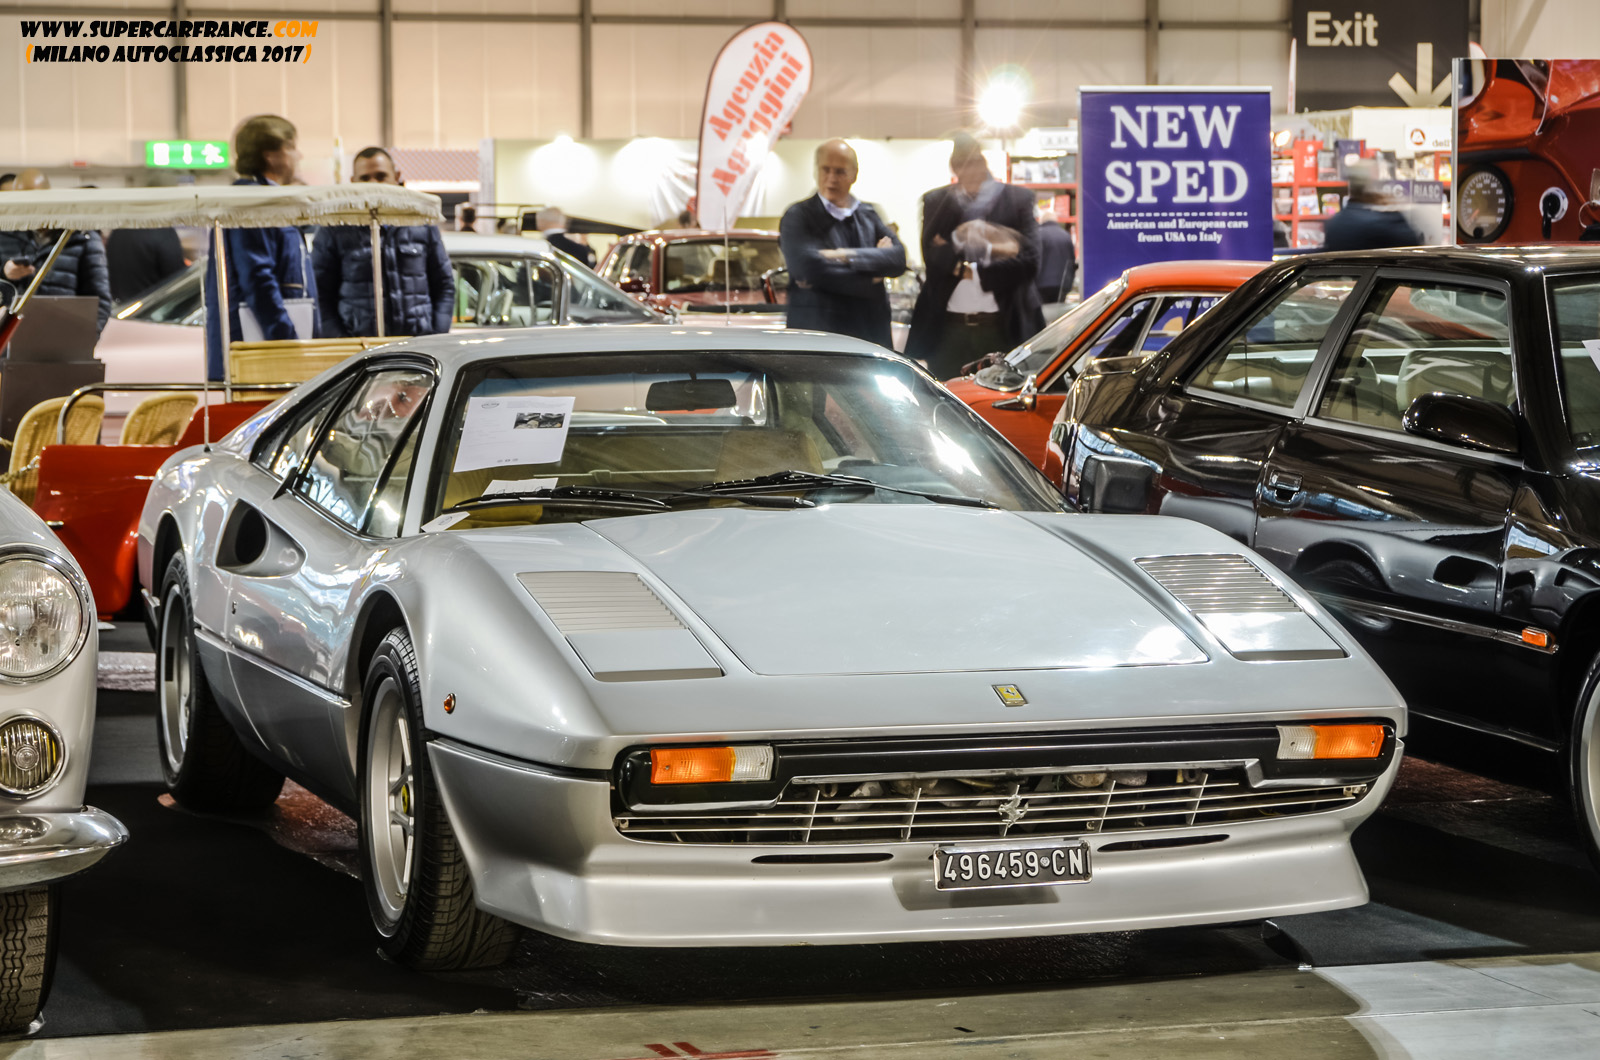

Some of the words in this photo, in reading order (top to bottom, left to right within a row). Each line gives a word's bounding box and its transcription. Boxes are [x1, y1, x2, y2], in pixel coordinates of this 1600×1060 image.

[1306, 11, 1378, 47] Exit
[709, 31, 785, 142] Agenzia
[1110, 105, 1242, 149] NEW
[1105, 160, 1249, 204] SPED
[1107, 219, 1156, 230] American
[1157, 218, 1177, 229] and
[1178, 218, 1226, 231] European
[1227, 220, 1249, 229] cars
[1137, 232, 1163, 243] from
[1164, 232, 1186, 242] USA
[1187, 232, 1198, 242] to
[1199, 231, 1223, 244] Italy
[944, 851, 1039, 880] 496459
[1052, 848, 1084, 876] CN
